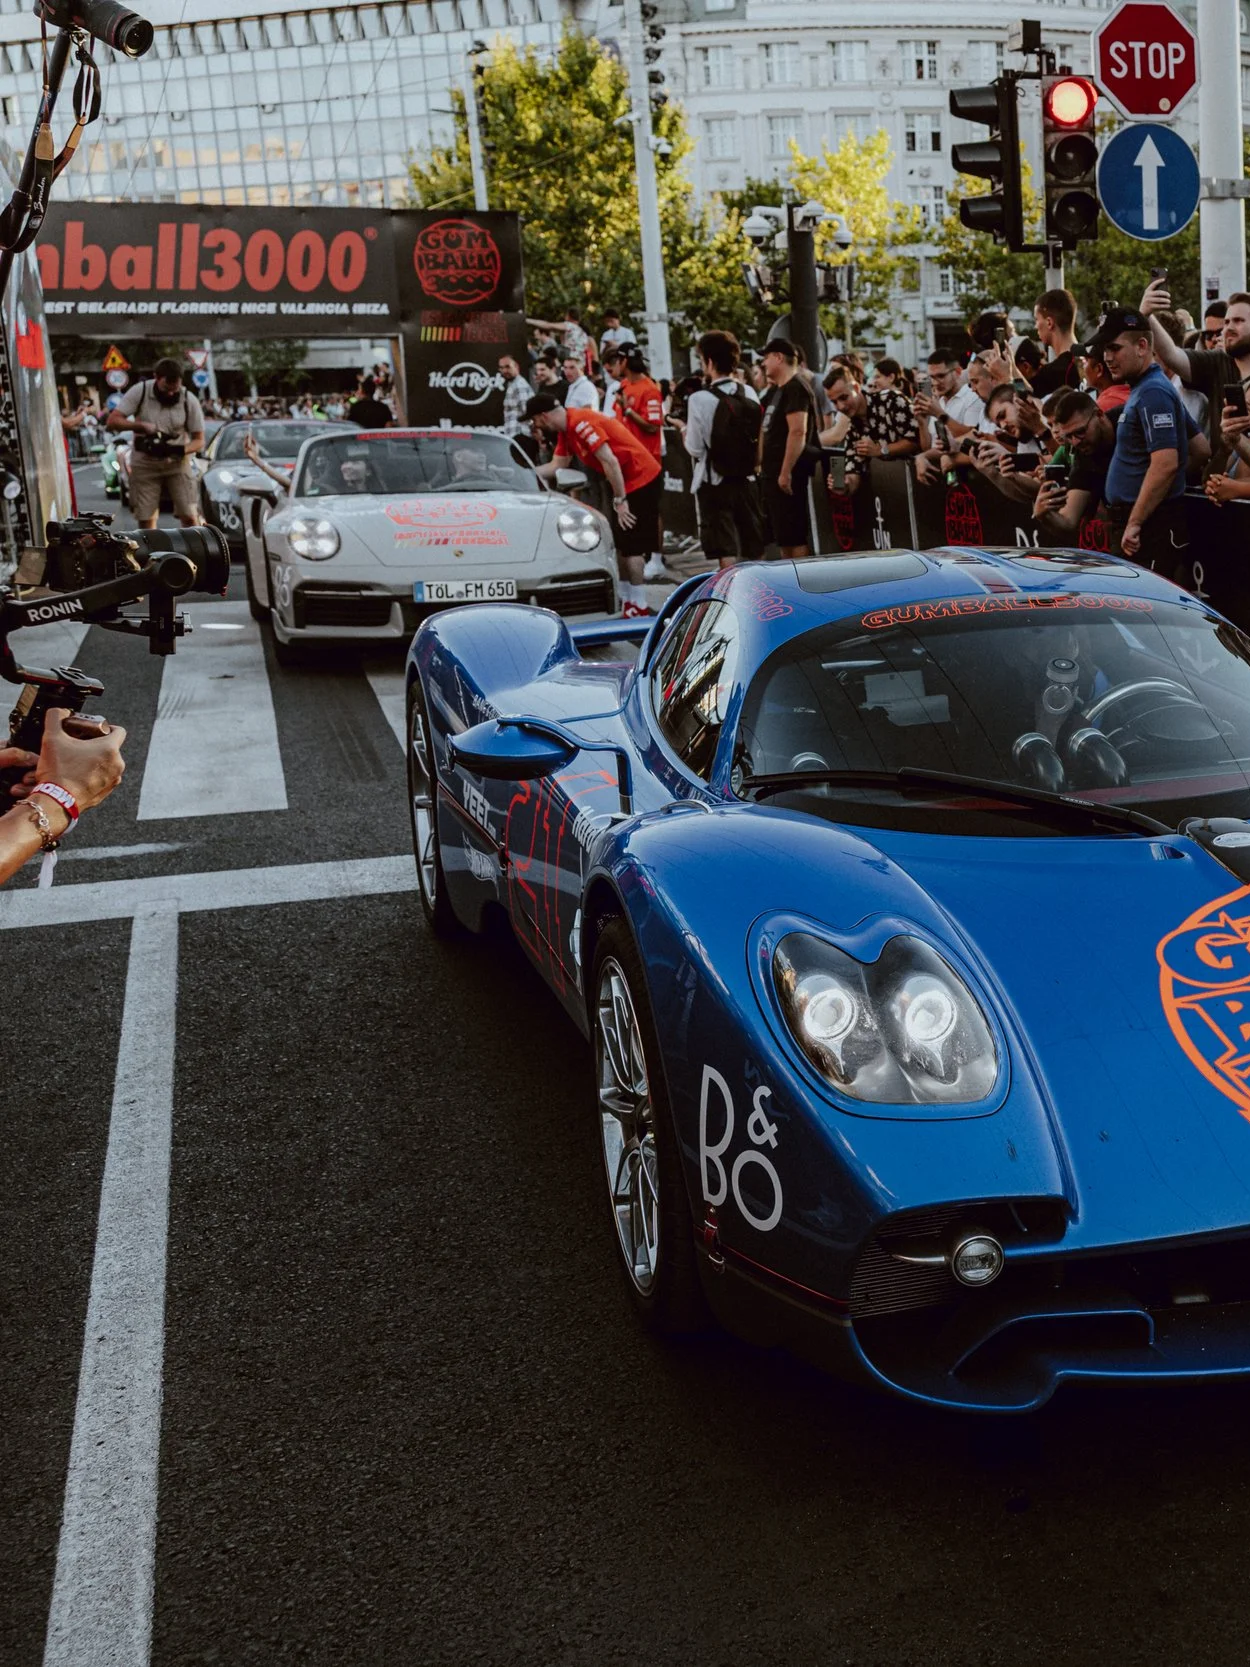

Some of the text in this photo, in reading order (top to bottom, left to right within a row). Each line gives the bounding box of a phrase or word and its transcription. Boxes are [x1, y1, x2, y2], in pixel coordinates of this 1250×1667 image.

[1109, 41, 1186, 79] STOP
[78, 302, 158, 315] BELGRADE
[161, 302, 239, 315] FLORENCE
[241, 302, 277, 315] NICE
[280, 302, 350, 316] VALENCIA
[352, 303, 390, 316] IBIZA
[428, 371, 506, 391] Hard Rock
[426, 581, 514, 599] TÖL FM 650
[27, 599, 84, 623] RONIN
[862, 595, 1153, 628] GUMBALL3000
